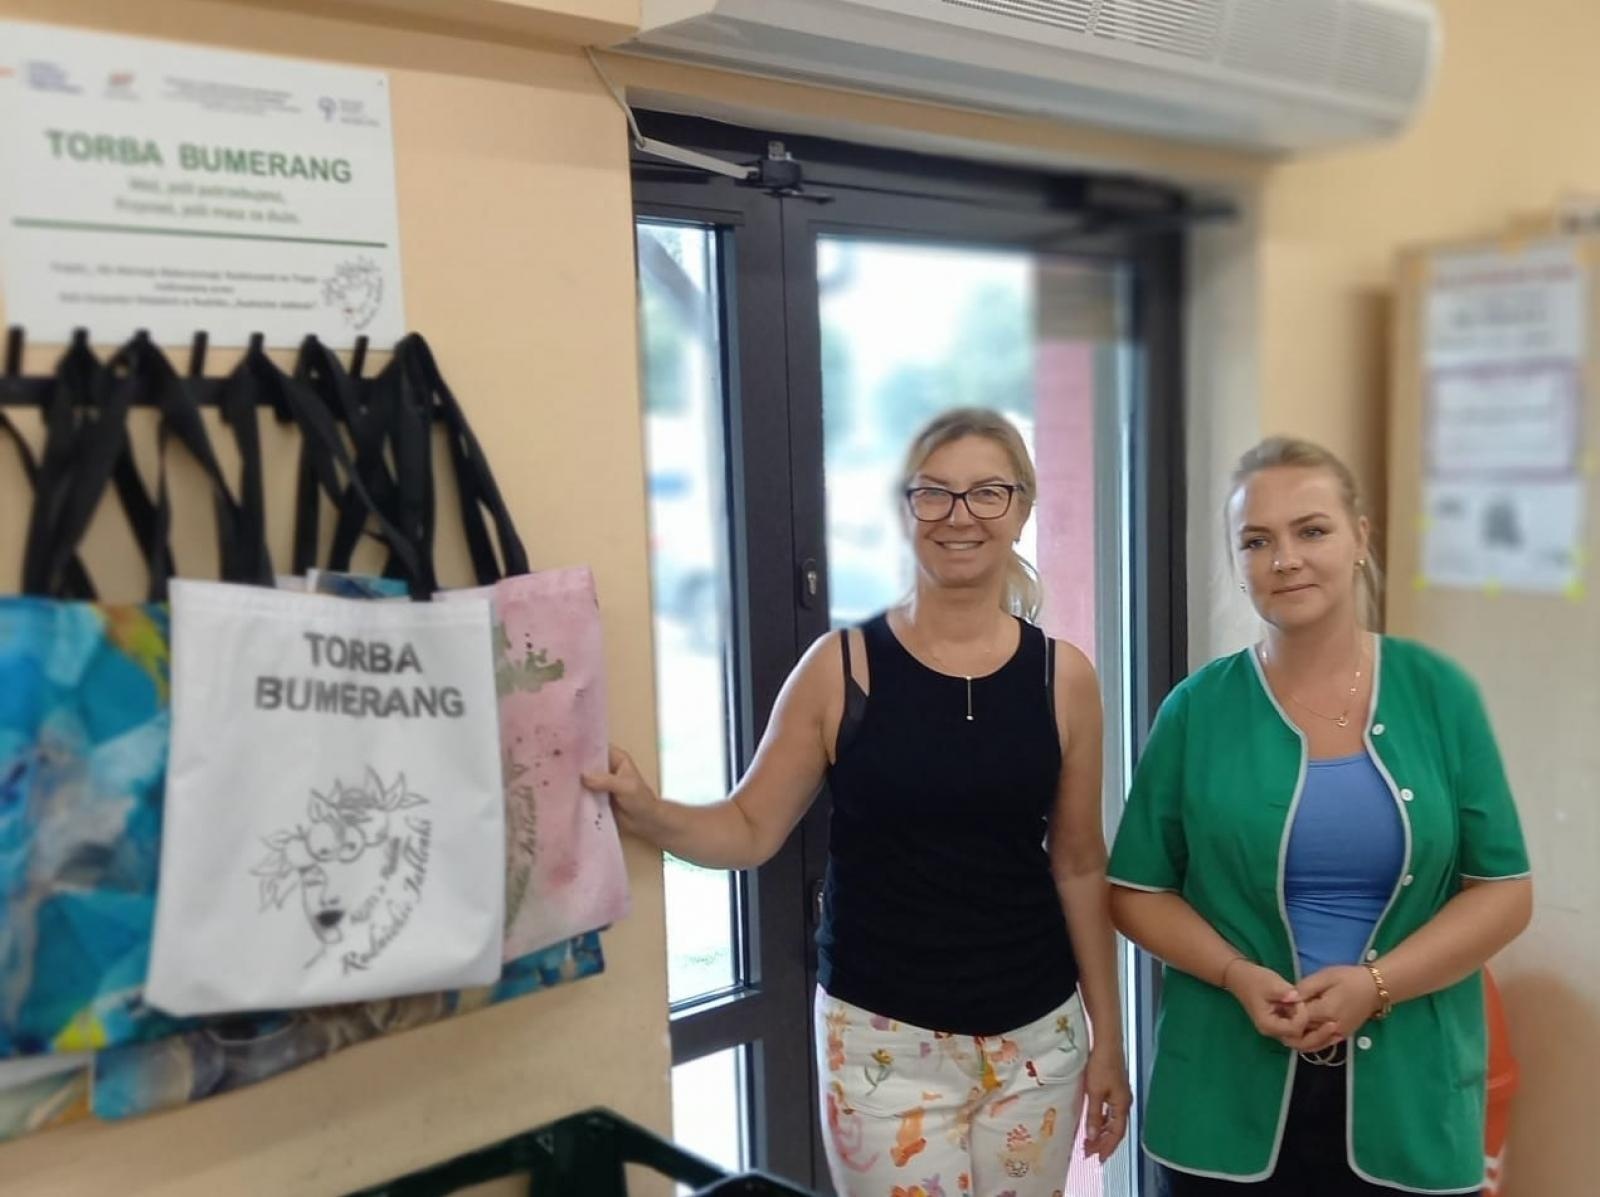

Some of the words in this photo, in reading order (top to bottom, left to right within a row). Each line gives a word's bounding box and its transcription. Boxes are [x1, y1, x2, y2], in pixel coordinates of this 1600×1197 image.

[46, 129, 163, 166] TORBA
[178, 142, 353, 184] BUMERANG
[304, 632, 423, 675] TORBA
[254, 676, 466, 718] BUMERANG
